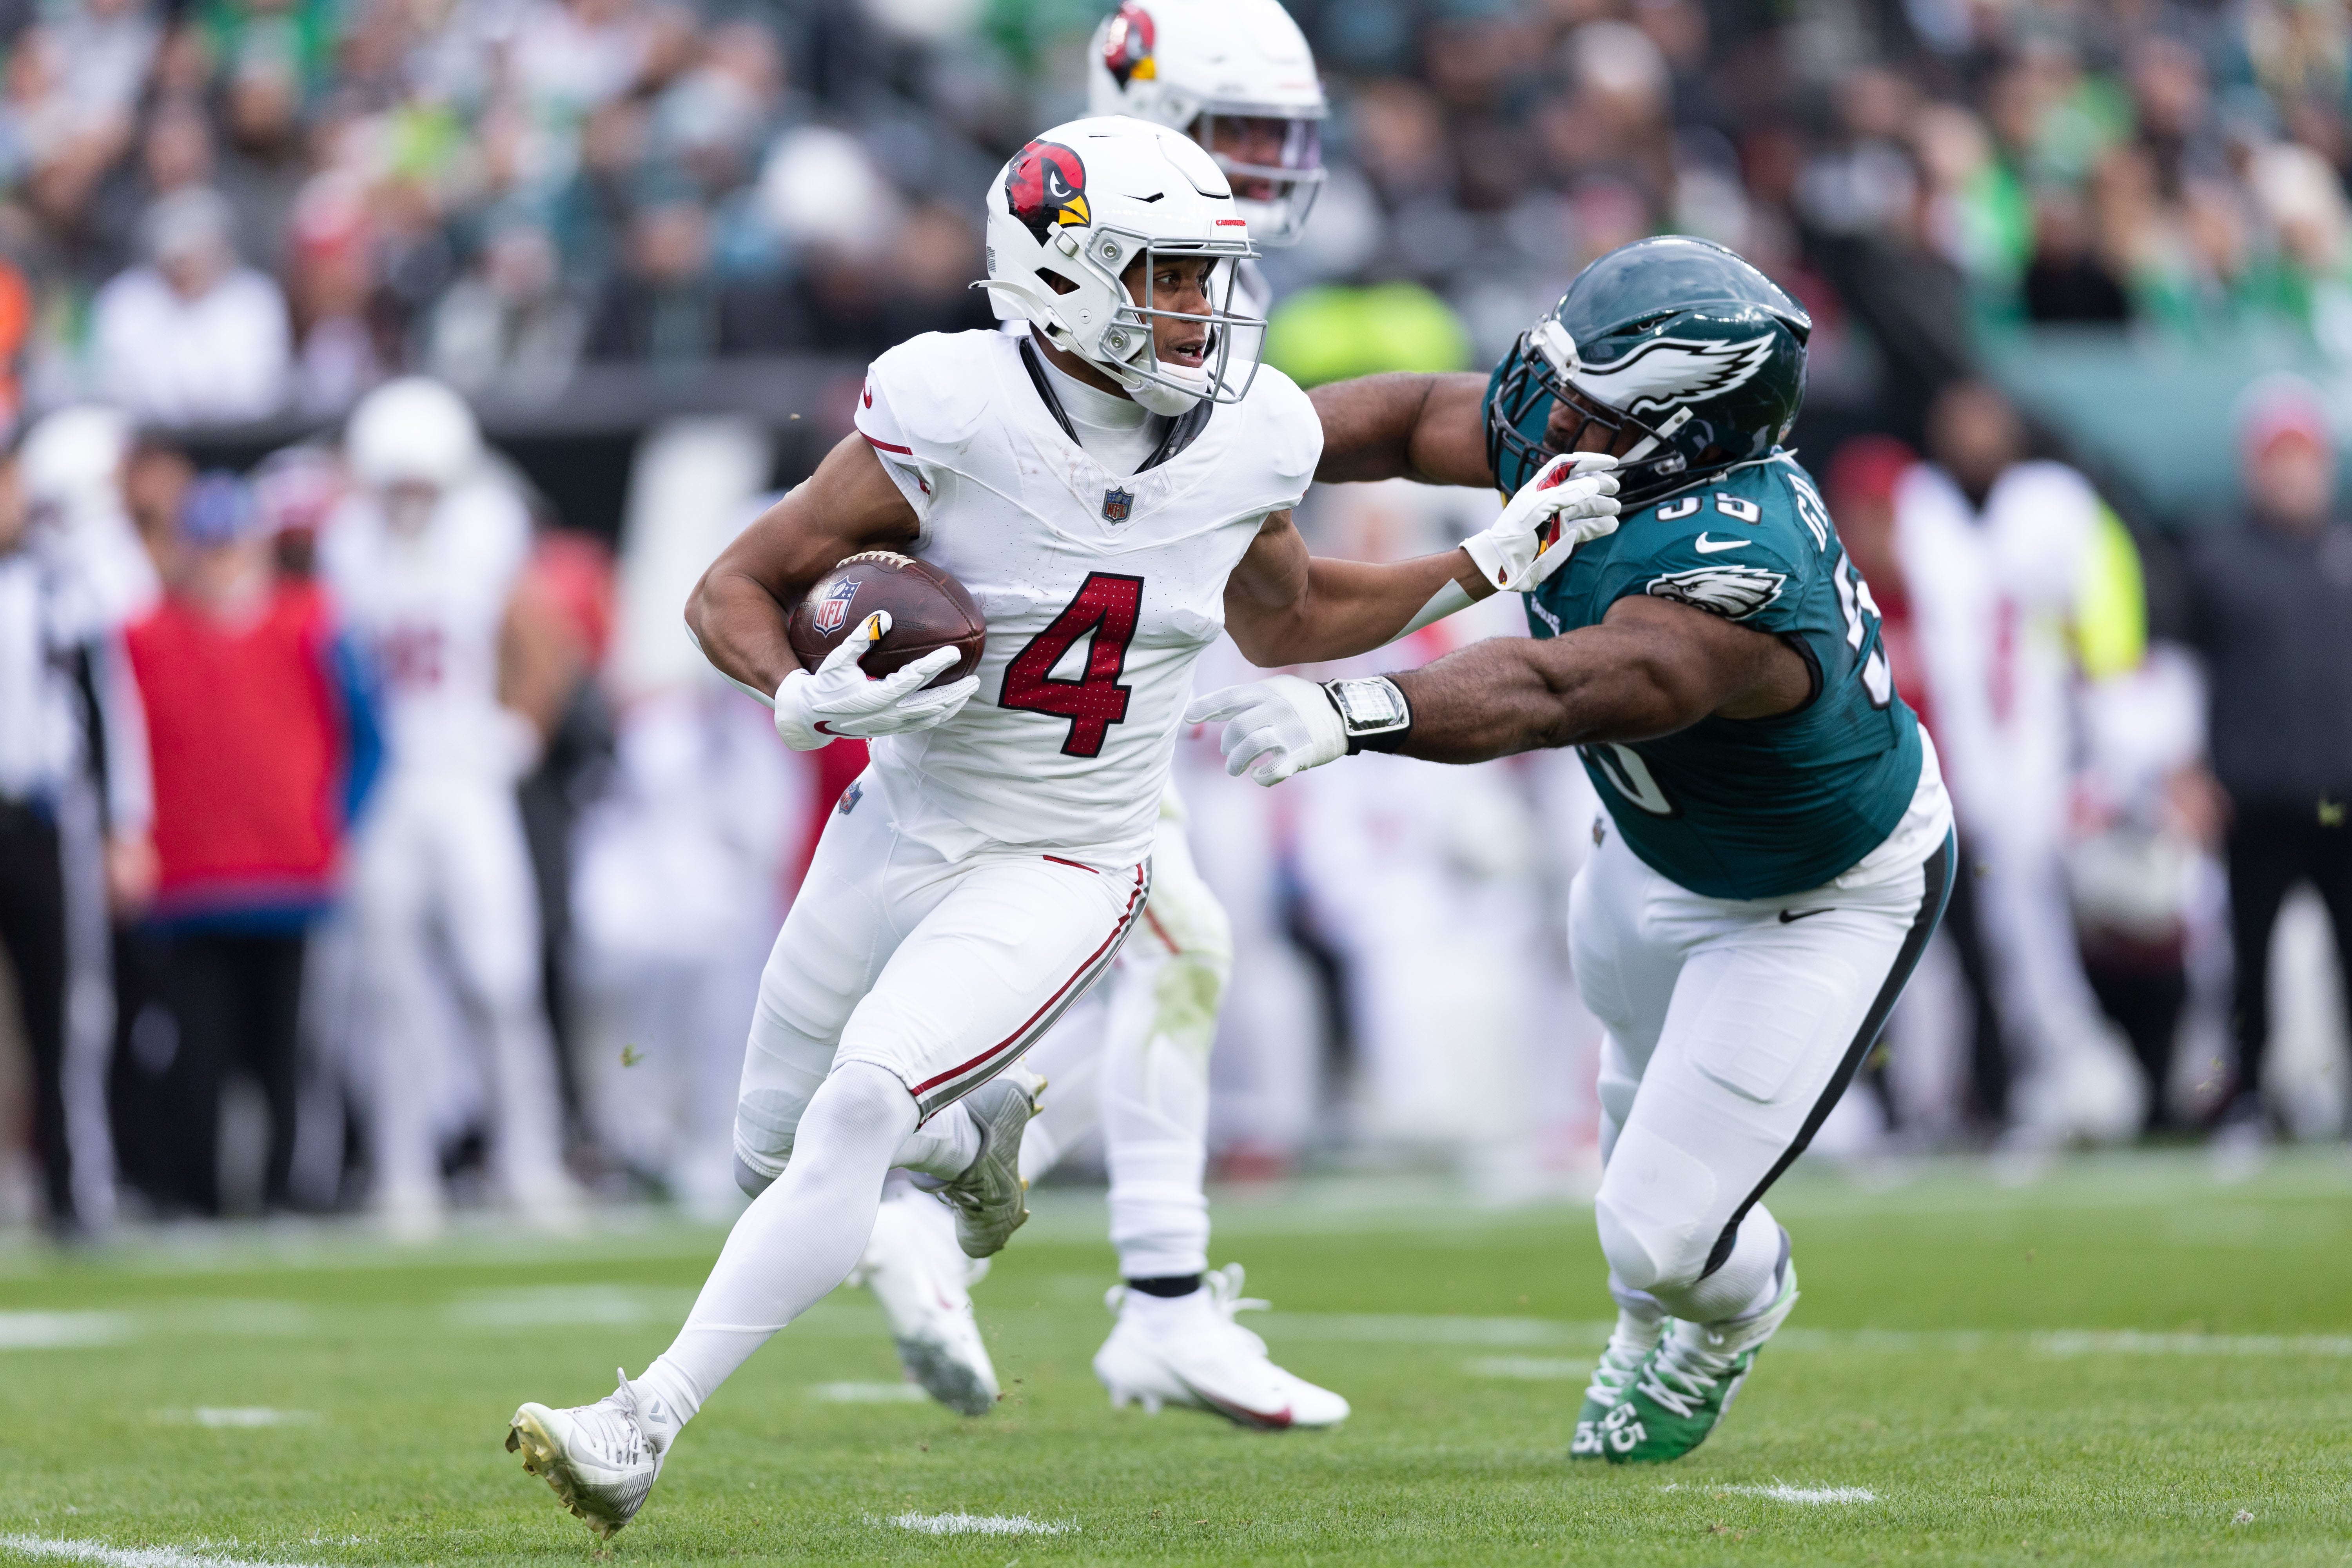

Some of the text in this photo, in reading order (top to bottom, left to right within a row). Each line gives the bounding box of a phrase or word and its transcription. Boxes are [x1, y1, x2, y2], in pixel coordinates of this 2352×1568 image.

[1106, 502, 1126, 519] NFL
[816, 600, 844, 628] NFL
[998, 571, 1144, 758] 4
